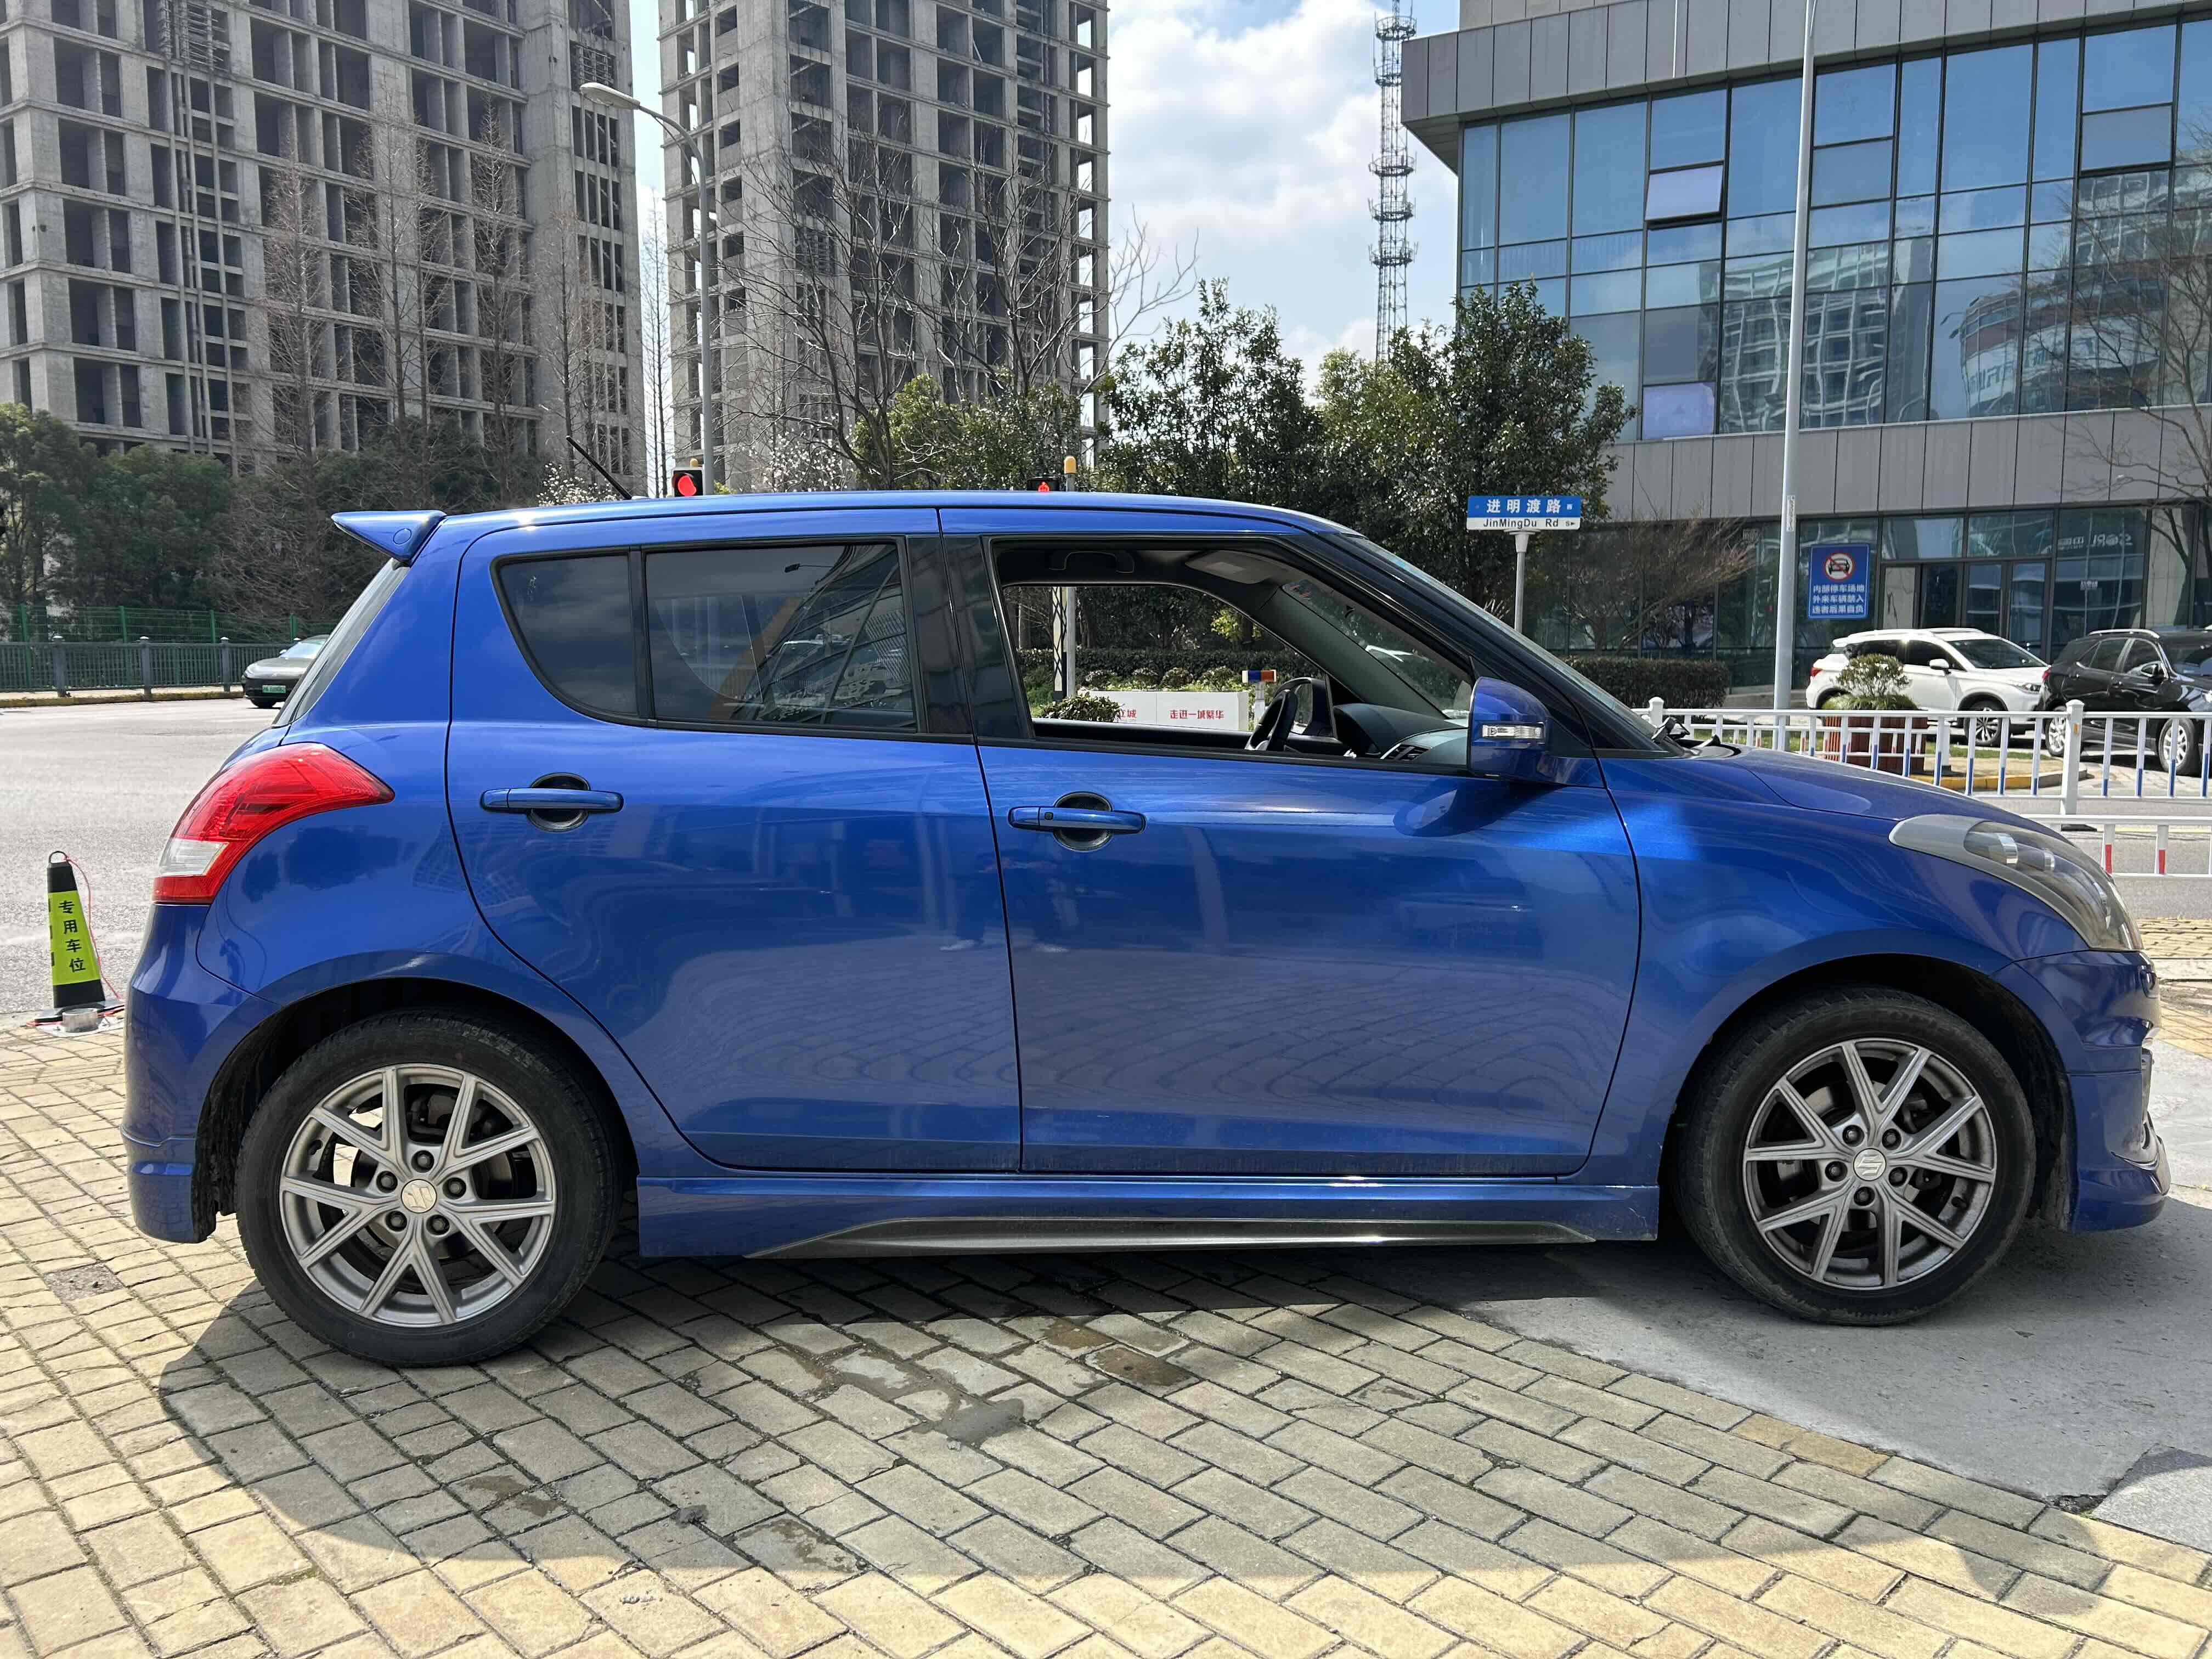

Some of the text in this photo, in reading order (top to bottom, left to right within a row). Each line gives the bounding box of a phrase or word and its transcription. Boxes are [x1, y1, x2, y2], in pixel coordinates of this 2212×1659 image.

[1486, 498, 1561, 514] 进明渡路
[1483, 518, 1537, 529] JinMingDu
[1545, 518, 1559, 527] Rd
[1813, 584, 1865, 593] 内部停车场地
[1812, 605, 1864, 614] 违者后果自负
[58, 900, 86, 973] 专用车位
